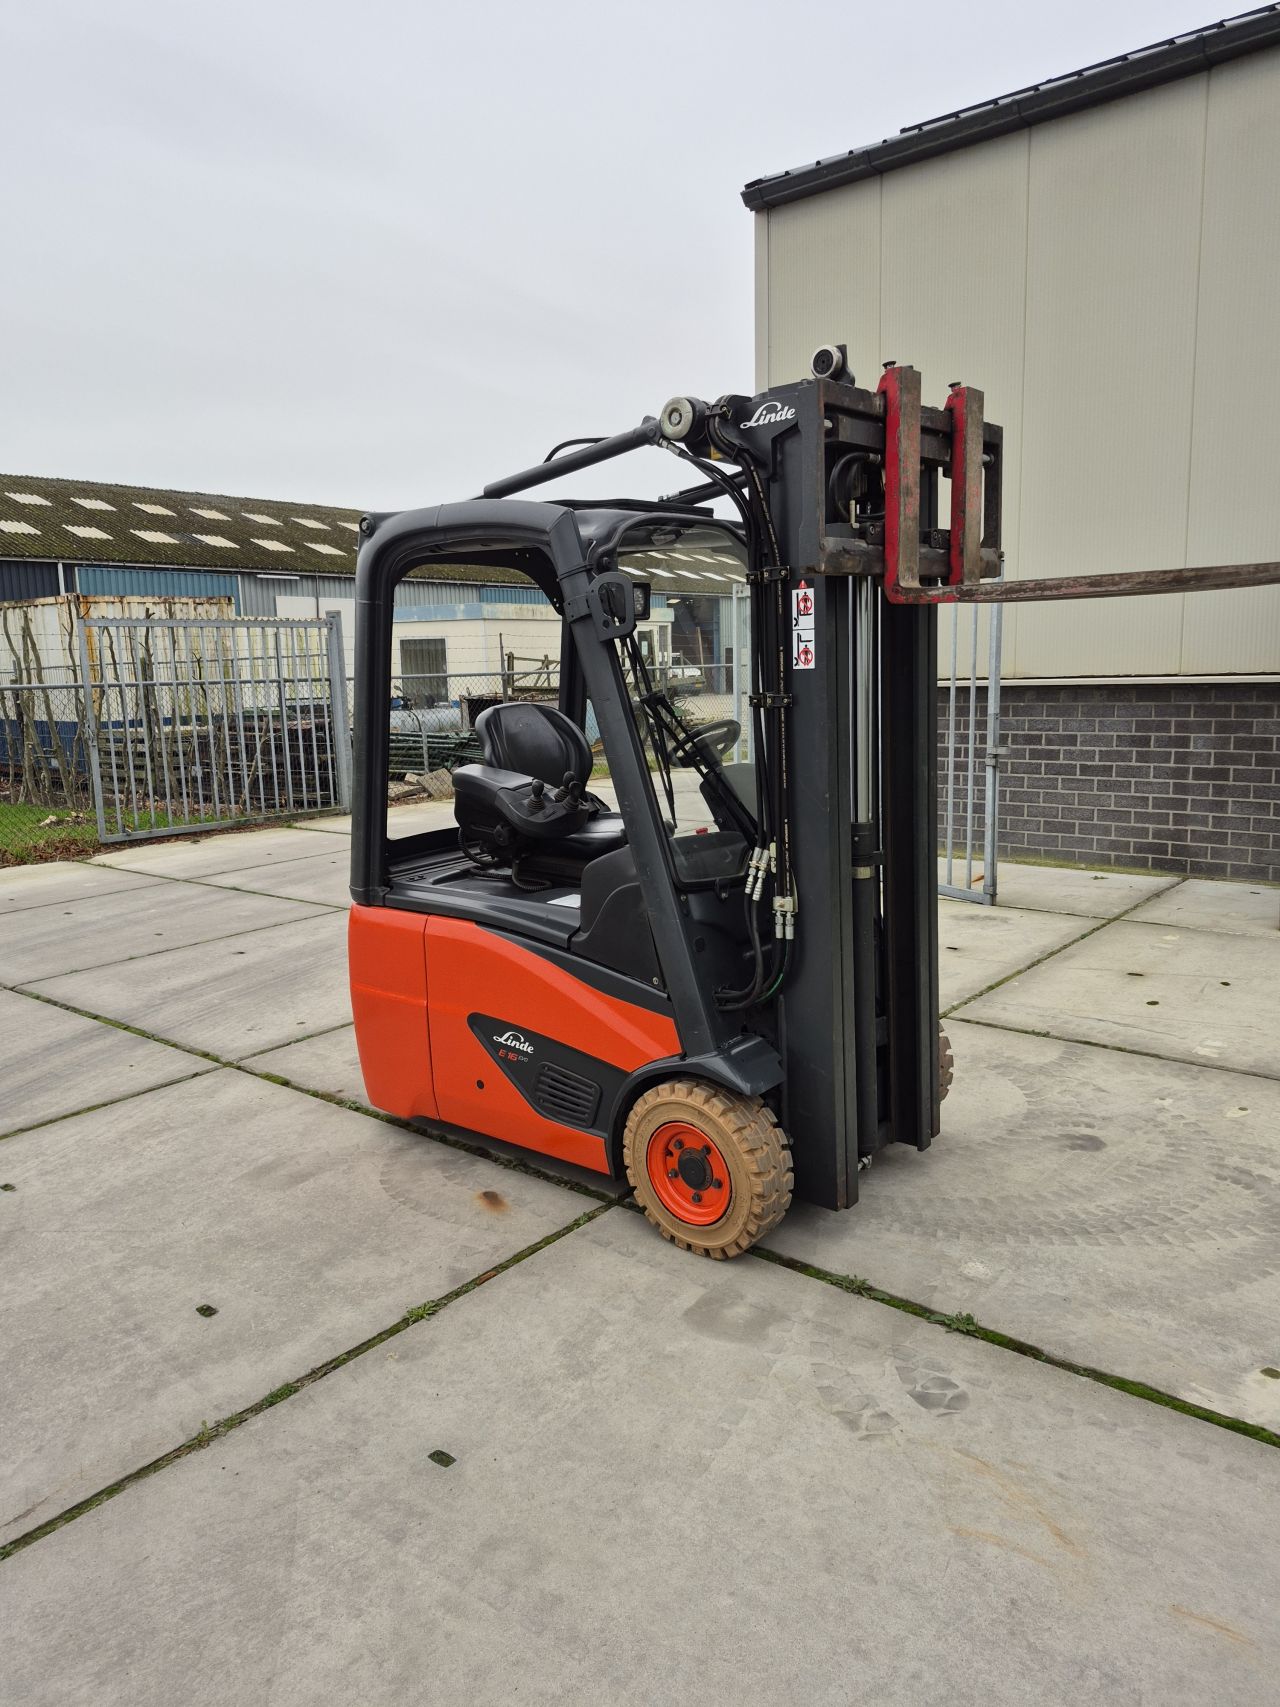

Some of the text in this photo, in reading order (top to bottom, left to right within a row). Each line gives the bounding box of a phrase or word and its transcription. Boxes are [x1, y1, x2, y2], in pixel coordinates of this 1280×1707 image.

[740, 402, 796, 429] Linde
[493, 1031, 534, 1053] Linde
[498, 1049, 506, 1057] E
[507, 1051, 518, 1061] 16
